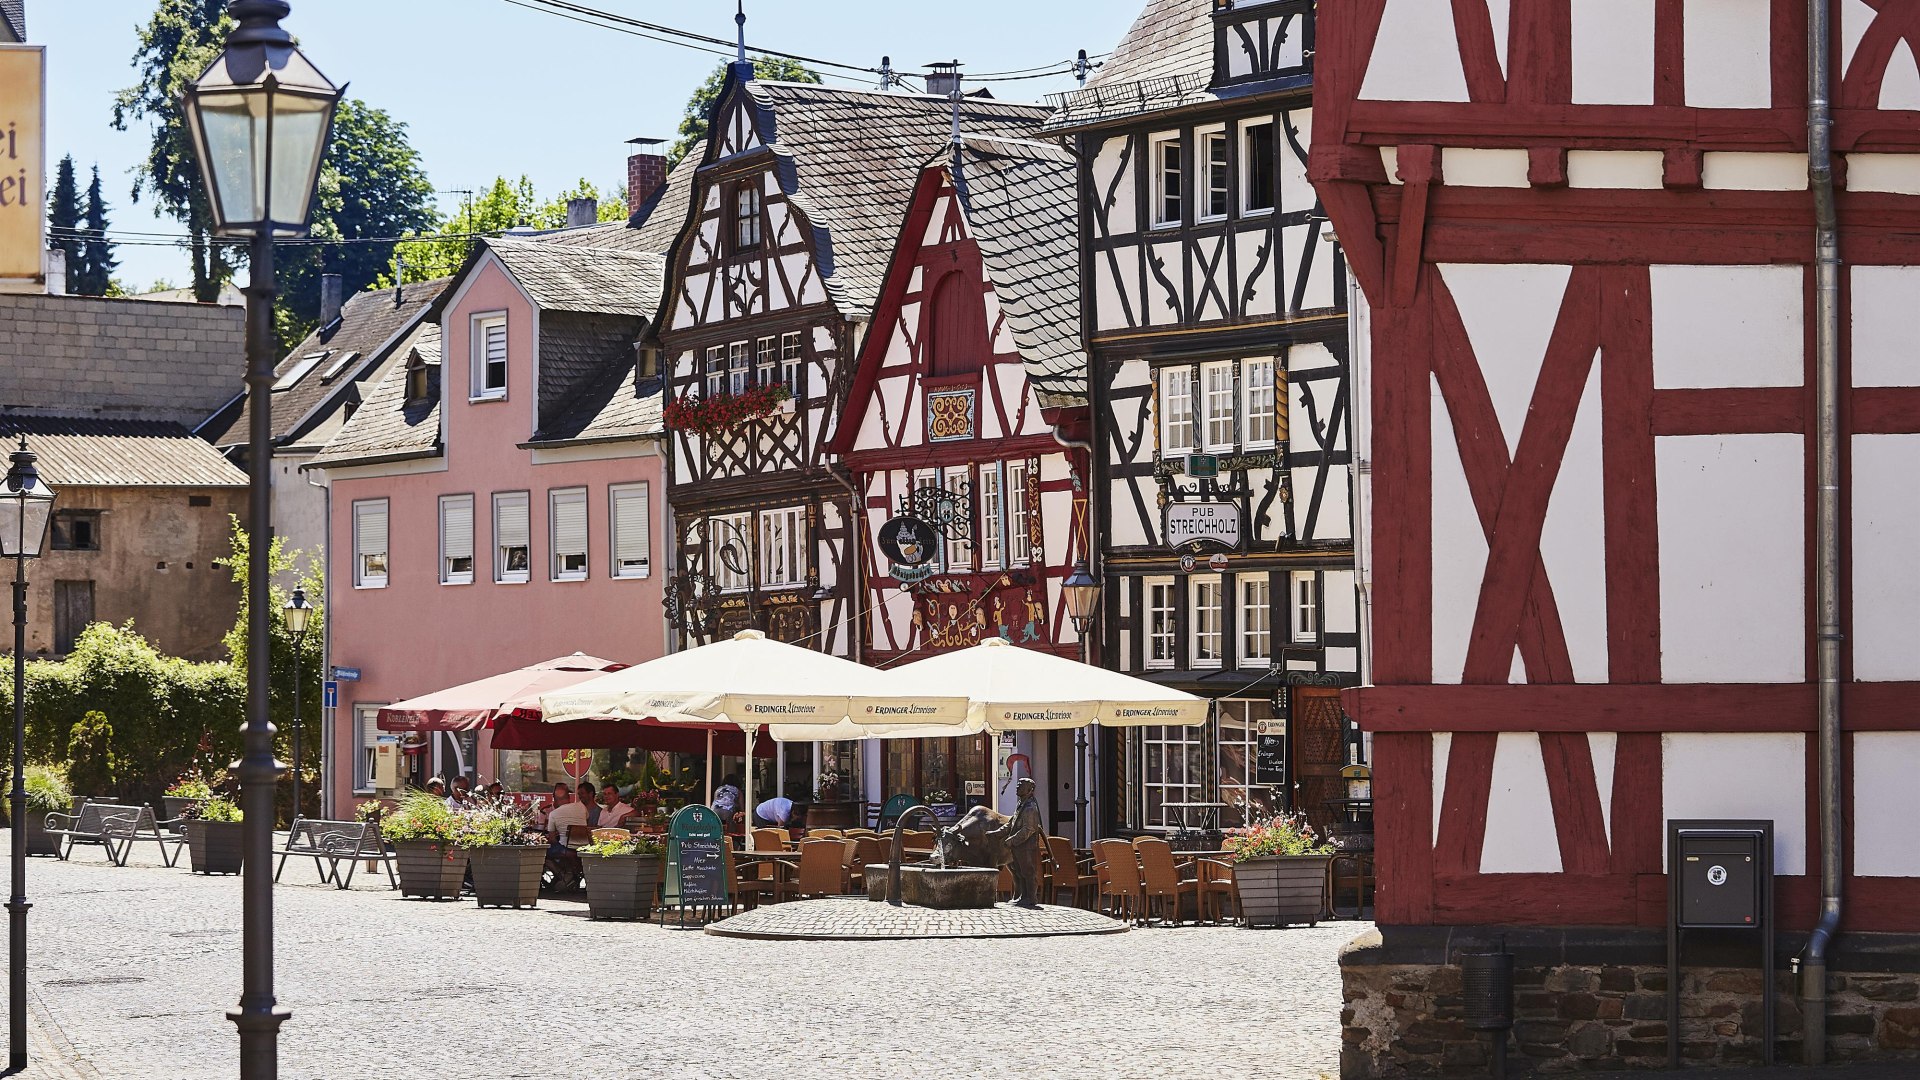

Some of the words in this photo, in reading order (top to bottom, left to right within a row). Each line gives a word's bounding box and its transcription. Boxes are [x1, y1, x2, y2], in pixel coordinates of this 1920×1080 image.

[1192, 507, 1214, 517] PUB
[1170, 519, 1237, 534] STREICHHOLZ
[754, 704, 787, 714] ERDINGER
[875, 705, 909, 715] ERDINGER
[1122, 708, 1152, 717] ERDINGER
[1013, 711, 1046, 721] ERDINGER
